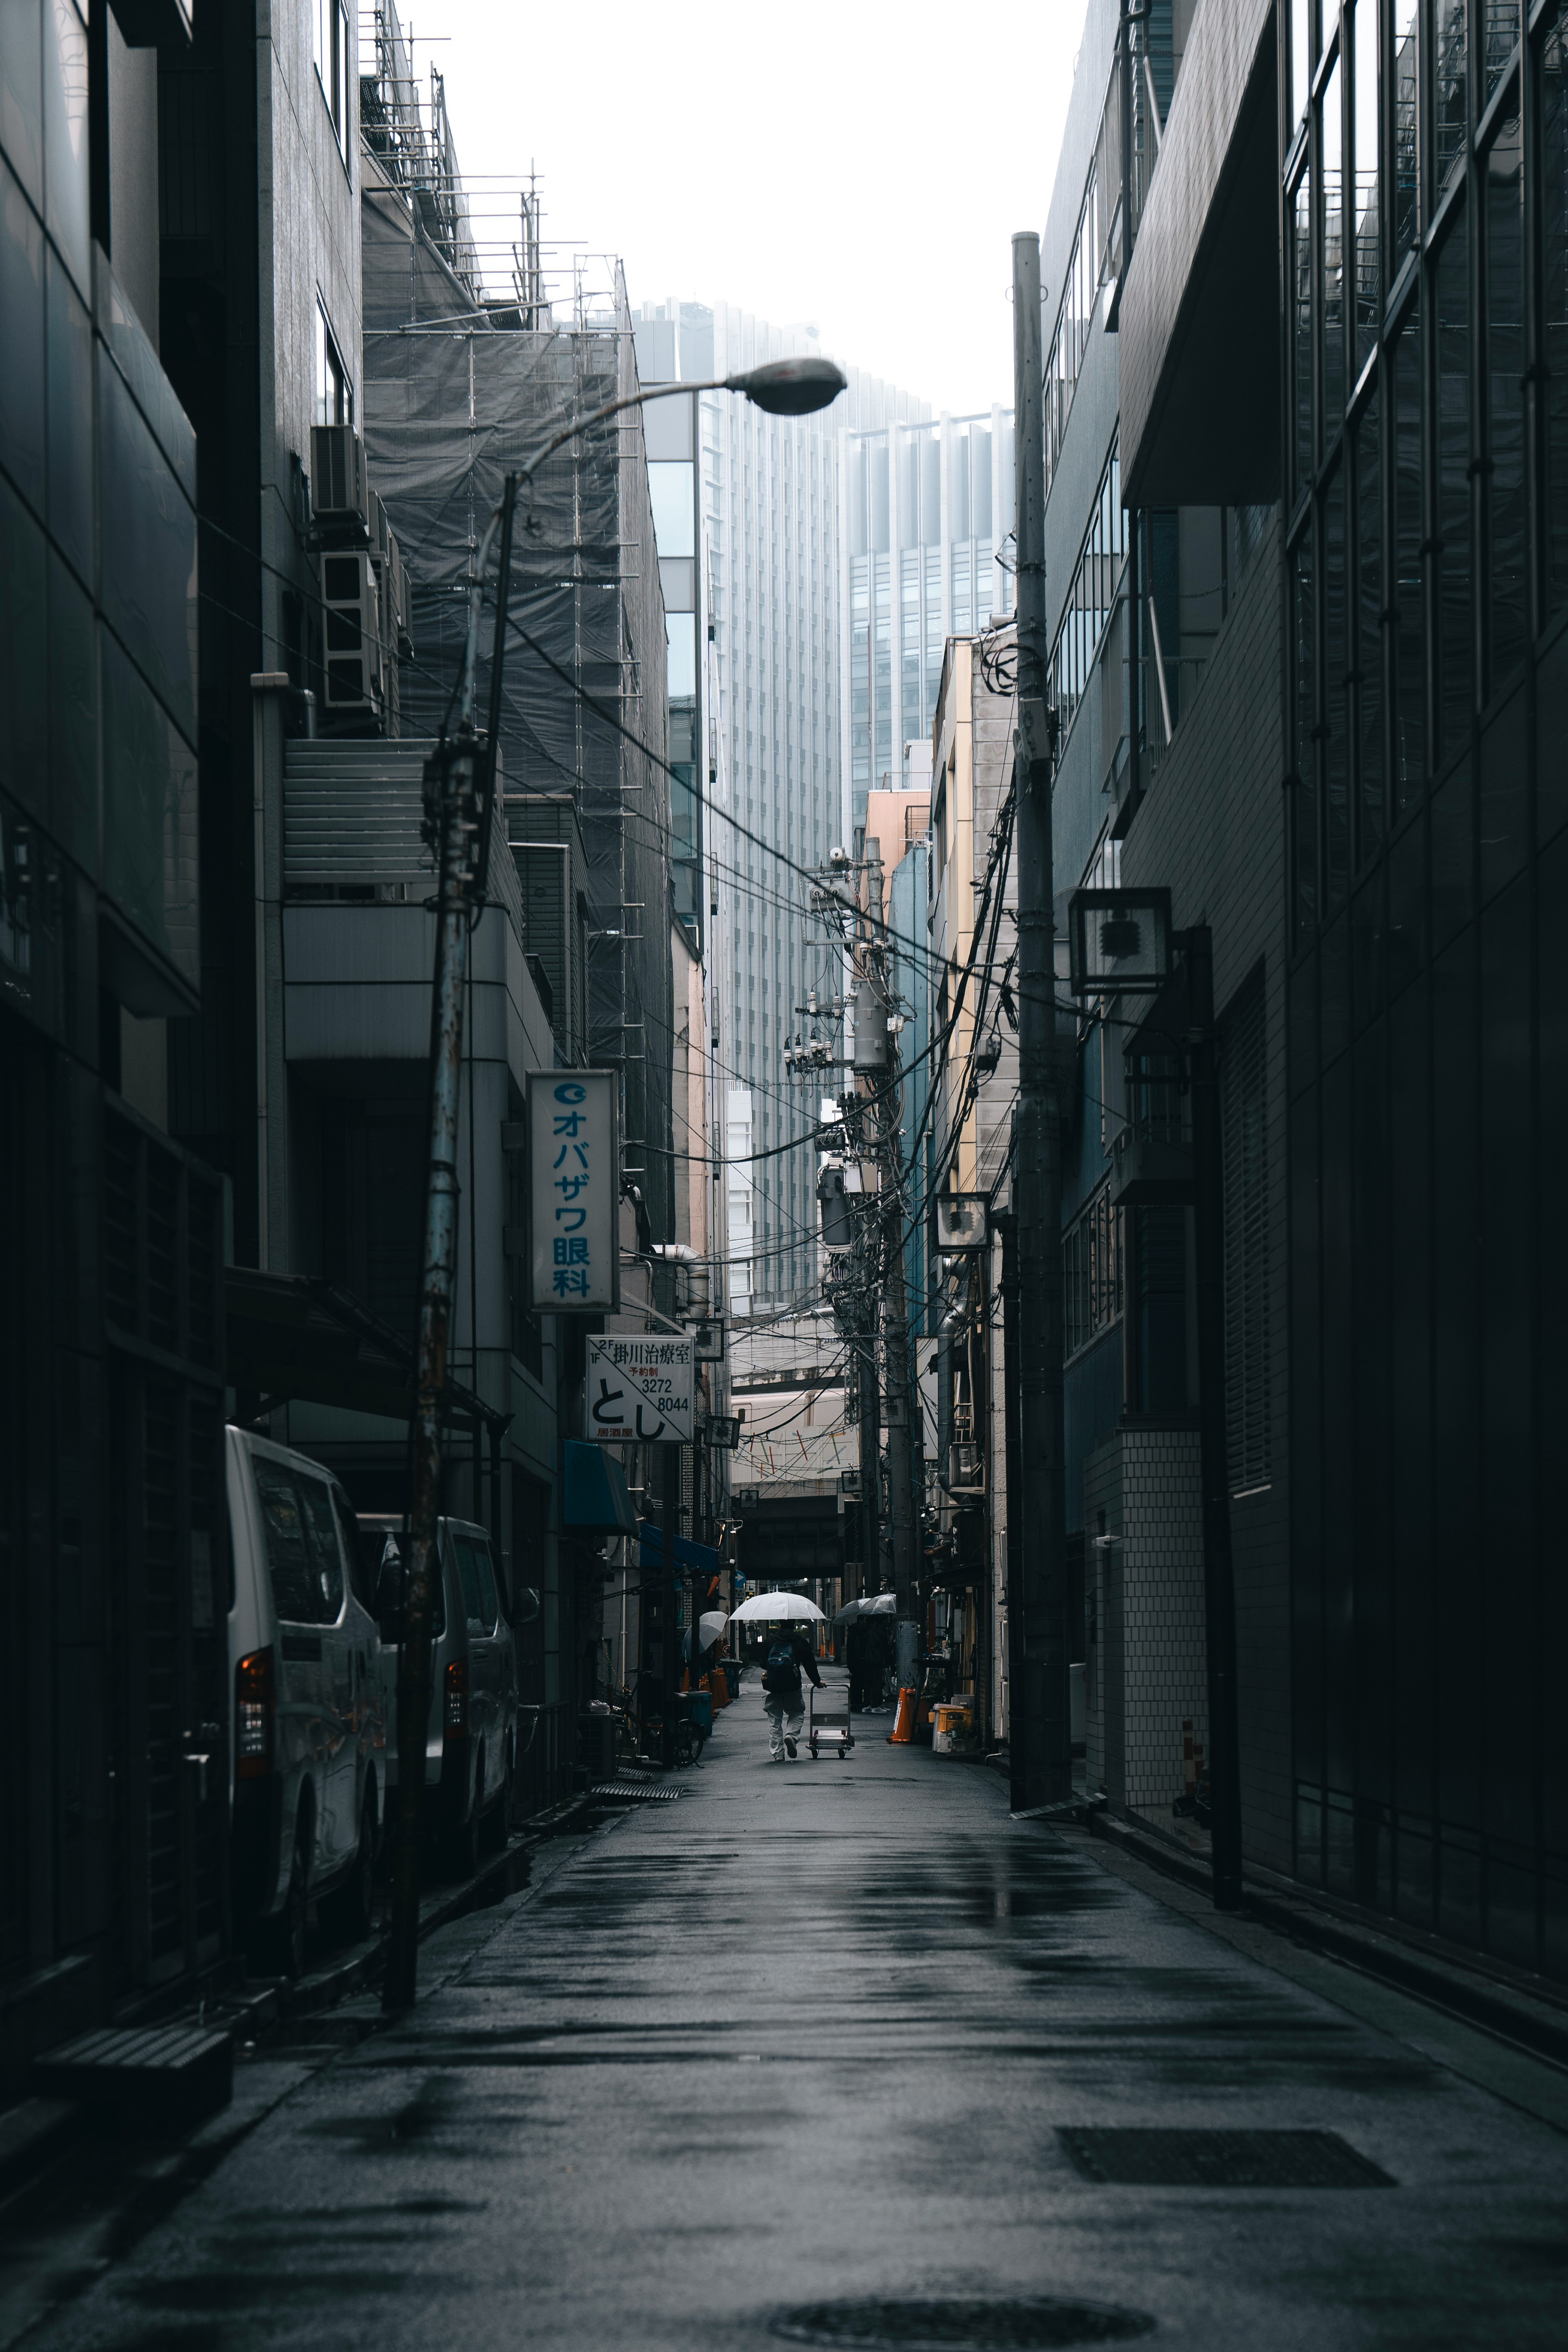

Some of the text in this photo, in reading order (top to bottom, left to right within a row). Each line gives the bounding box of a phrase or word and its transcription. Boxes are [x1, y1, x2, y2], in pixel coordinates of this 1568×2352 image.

[553, 1111, 590, 1298] オバザワ眼科
[590, 1353, 600, 1364] 1F
[599, 1340, 690, 1364] 2F 掛川治療室
[629, 1367, 658, 1377] 予約制
[642, 1379, 672, 1393] 3272
[592, 1378, 666, 1440] とし
[658, 1397, 688, 1411] 8044
[597, 1428, 633, 1437] 居酒屋
